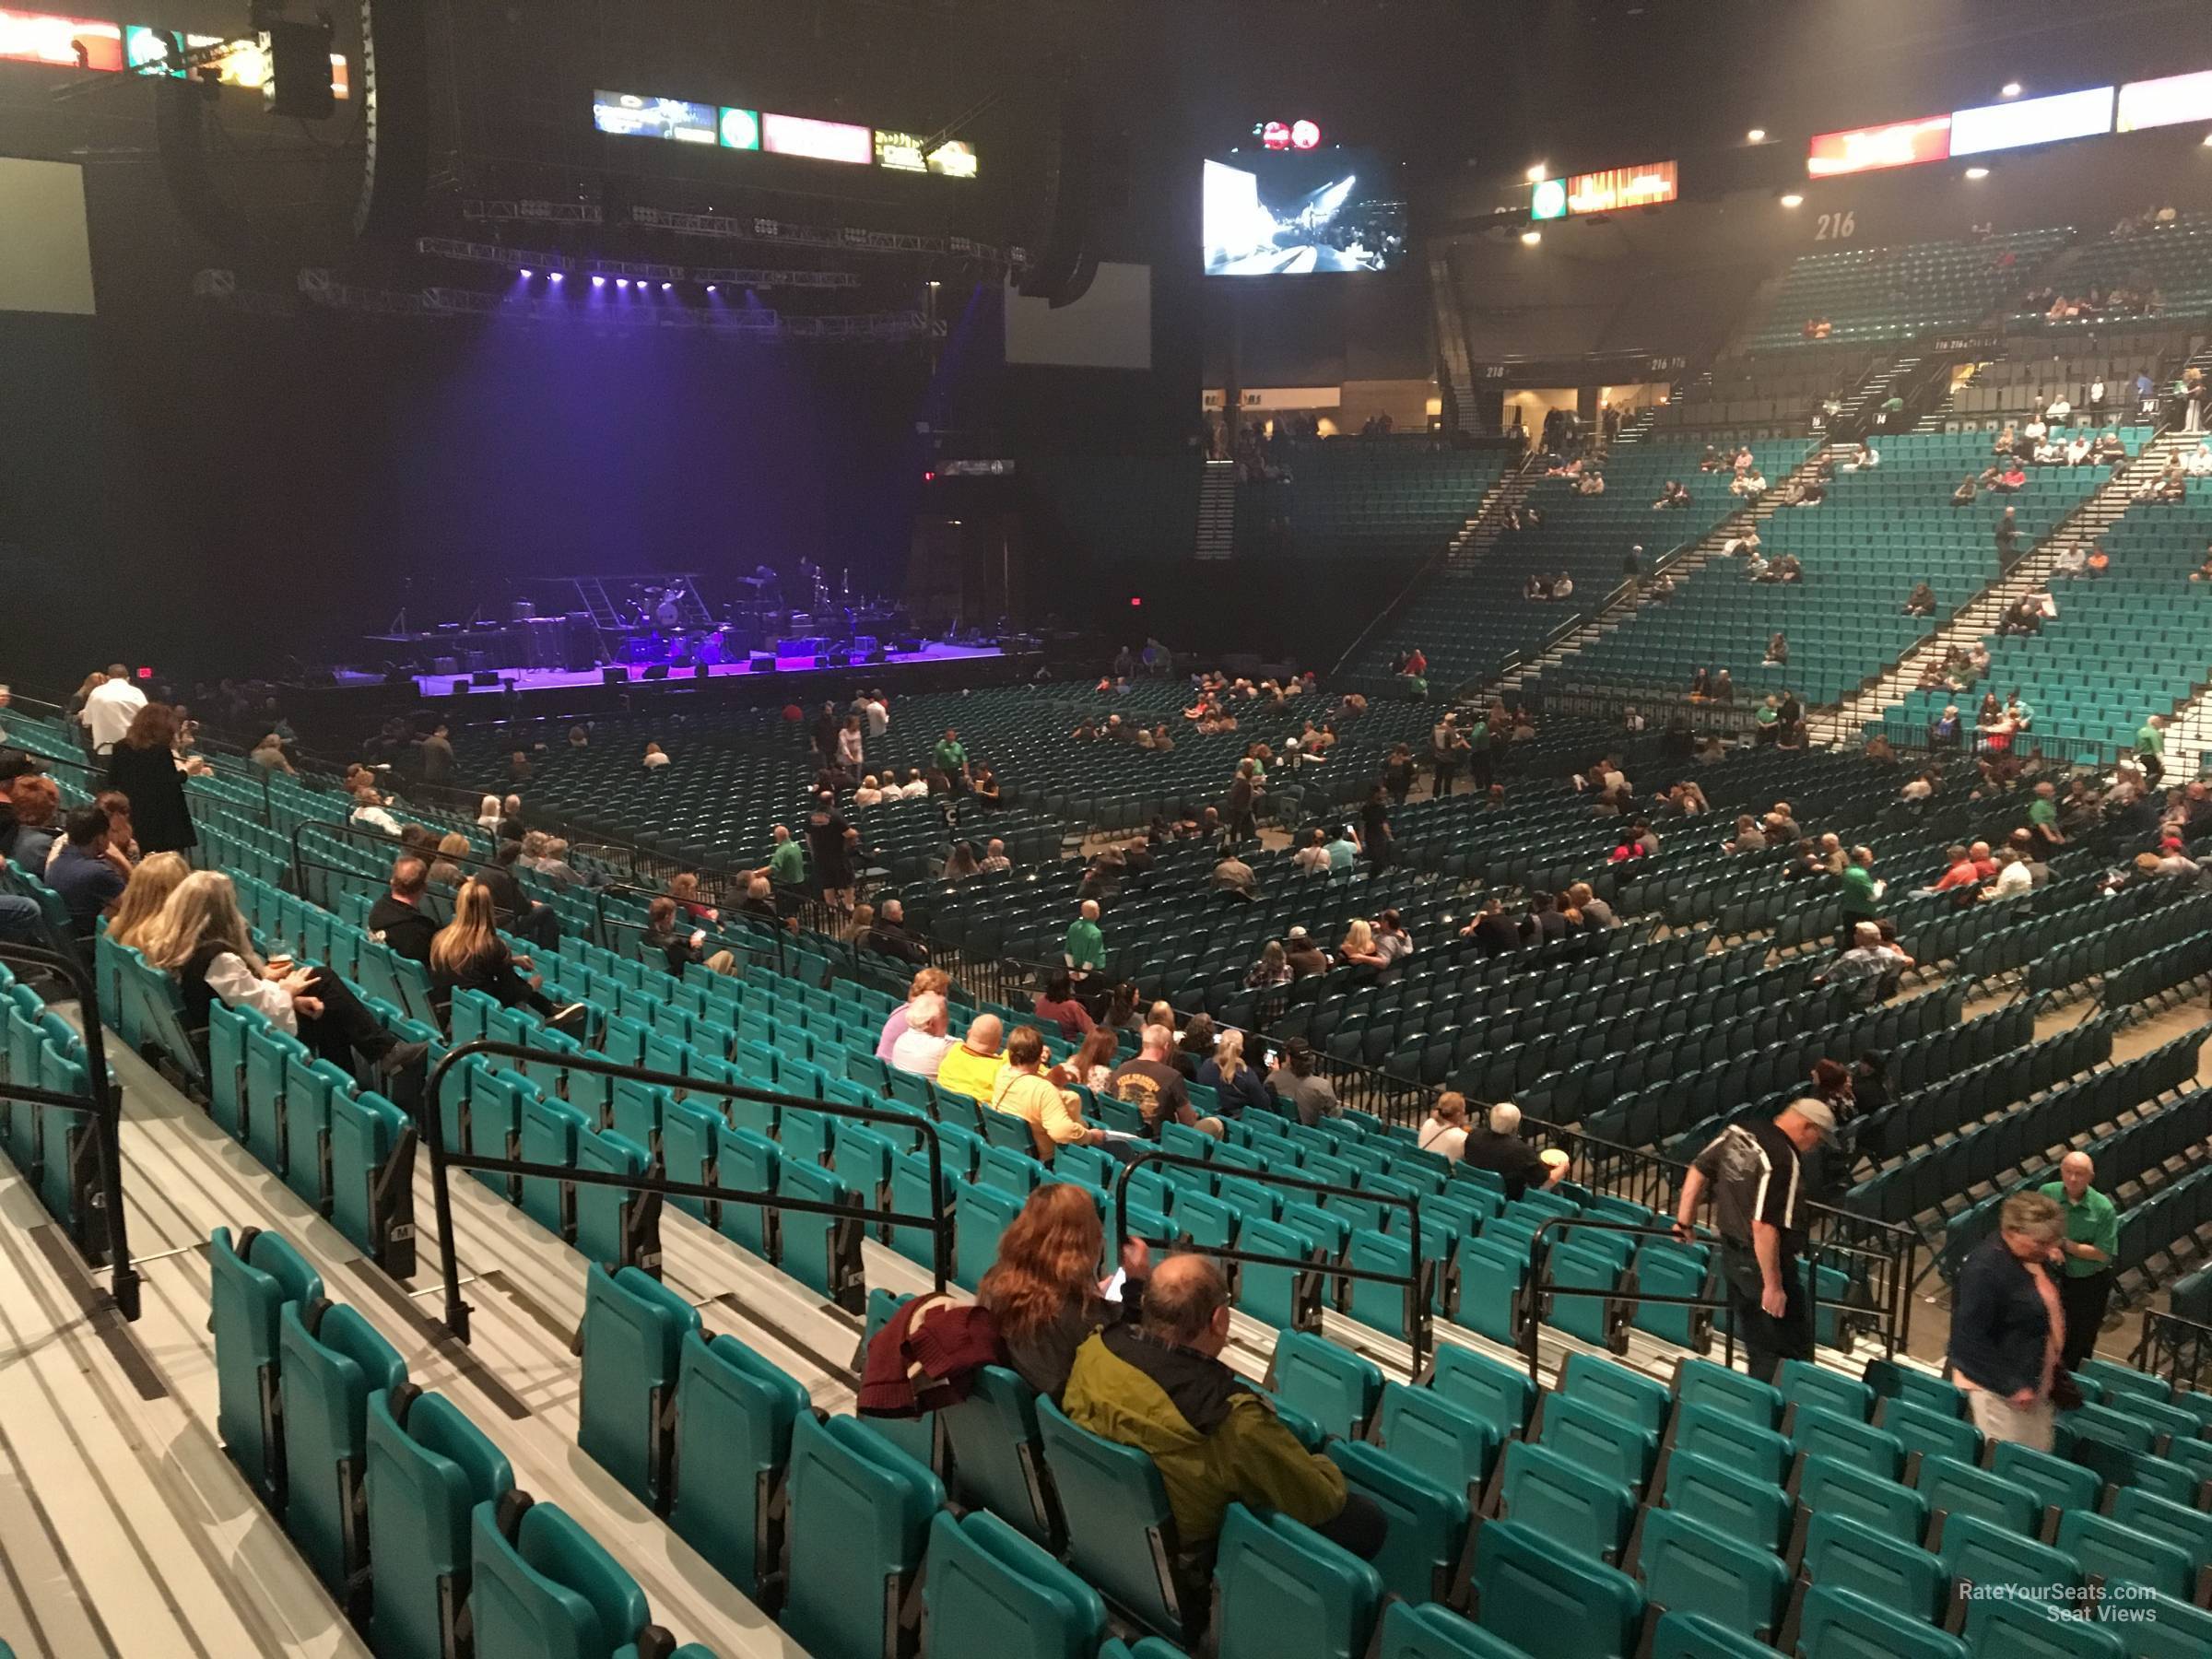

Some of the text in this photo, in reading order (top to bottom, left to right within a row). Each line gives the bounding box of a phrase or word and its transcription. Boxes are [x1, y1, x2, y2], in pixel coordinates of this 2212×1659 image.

[1815, 211, 1854, 241] 216
[945, 808, 957, 822] C
[396, 1227, 408, 1239] M
